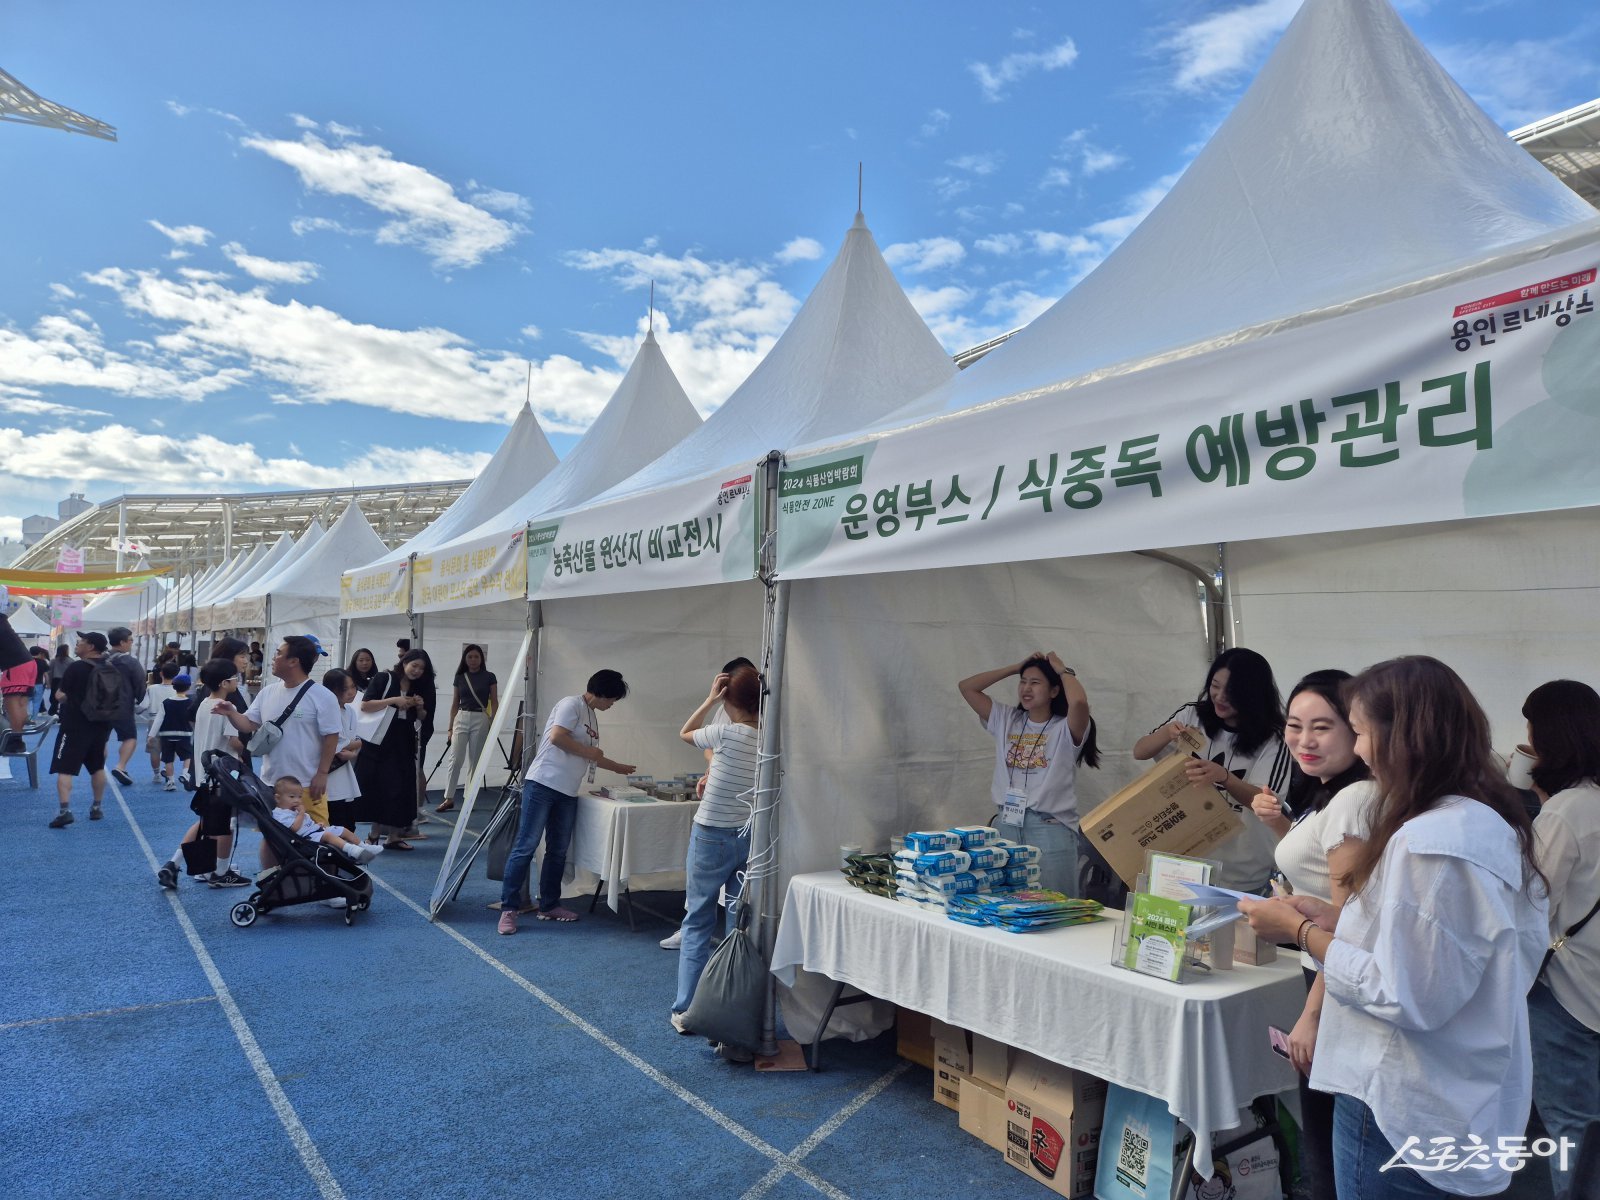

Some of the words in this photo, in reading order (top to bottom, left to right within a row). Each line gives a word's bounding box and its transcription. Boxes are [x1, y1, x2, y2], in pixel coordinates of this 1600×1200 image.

[1520, 286, 1539, 298] 함께
[1541, 280, 1569, 294] 만드는
[1572, 273, 1591, 285] 미래
[1450, 313, 1497, 352] 용인
[1502, 288, 1594, 334] 르네상스
[841, 474, 972, 540] 운영부스
[981, 465, 1005, 521] /
[1018, 433, 1163, 513] 식중독
[1185, 360, 1494, 488] 예방관리
[783, 478, 803, 490] 2024
[805, 464, 858, 488] 식품산업박람회
[782, 499, 811, 515] 식품안전
[812, 496, 835, 509] ZONE
[553, 539, 596, 577] 농축산물
[600, 529, 643, 569] 원산지
[648, 513, 723, 562] 비교전시
[1140, 834, 1158, 848] PLUS
[1147, 913, 1163, 922] 2024
[1016, 1107, 1031, 1120] 농심
